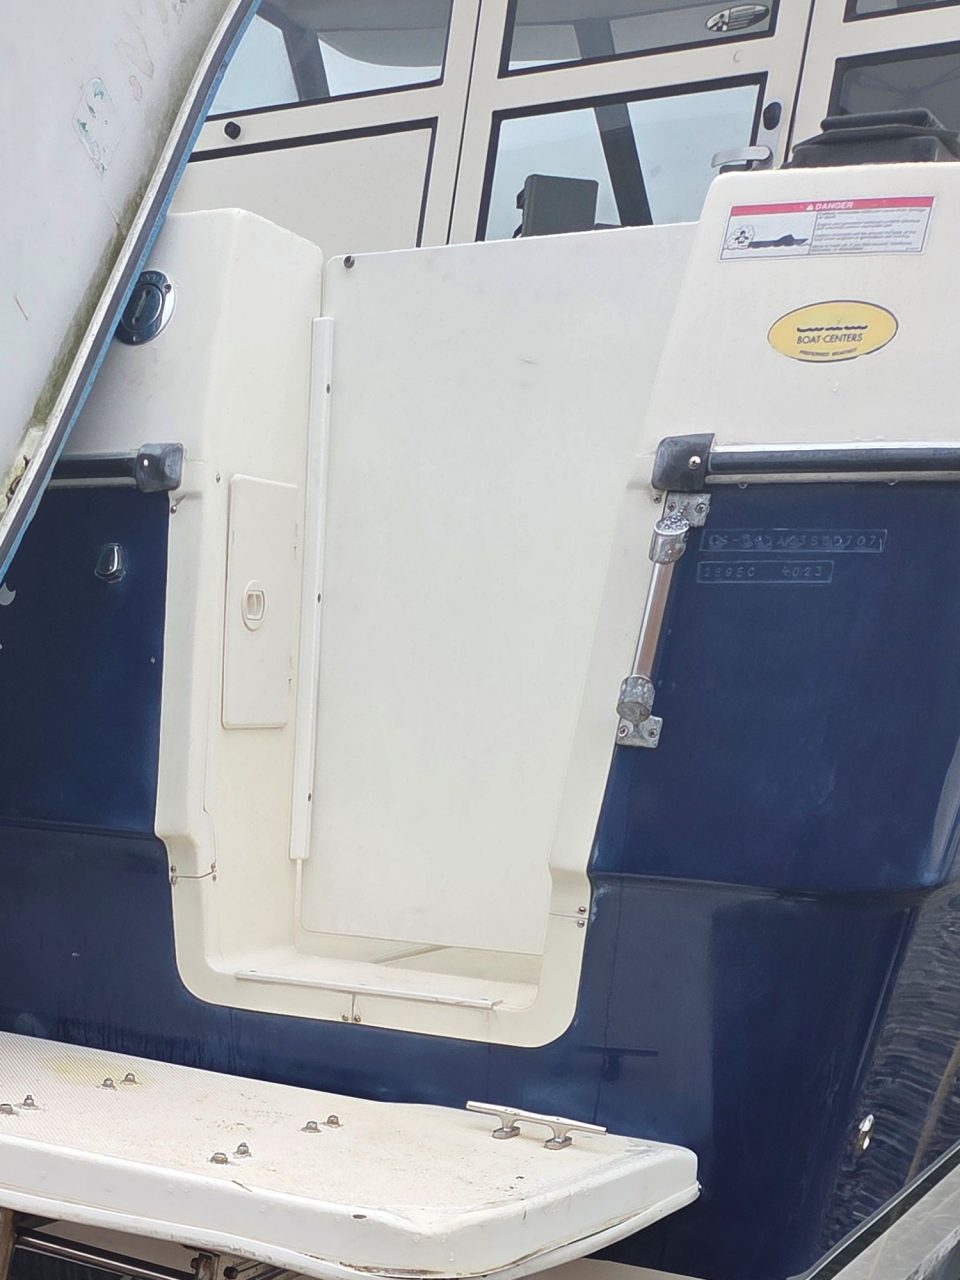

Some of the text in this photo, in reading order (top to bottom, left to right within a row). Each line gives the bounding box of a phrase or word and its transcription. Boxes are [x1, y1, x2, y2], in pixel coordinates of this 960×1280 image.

[815, 202, 853, 210] DANGER
[797, 333, 863, 344] BOAT CENTERS
